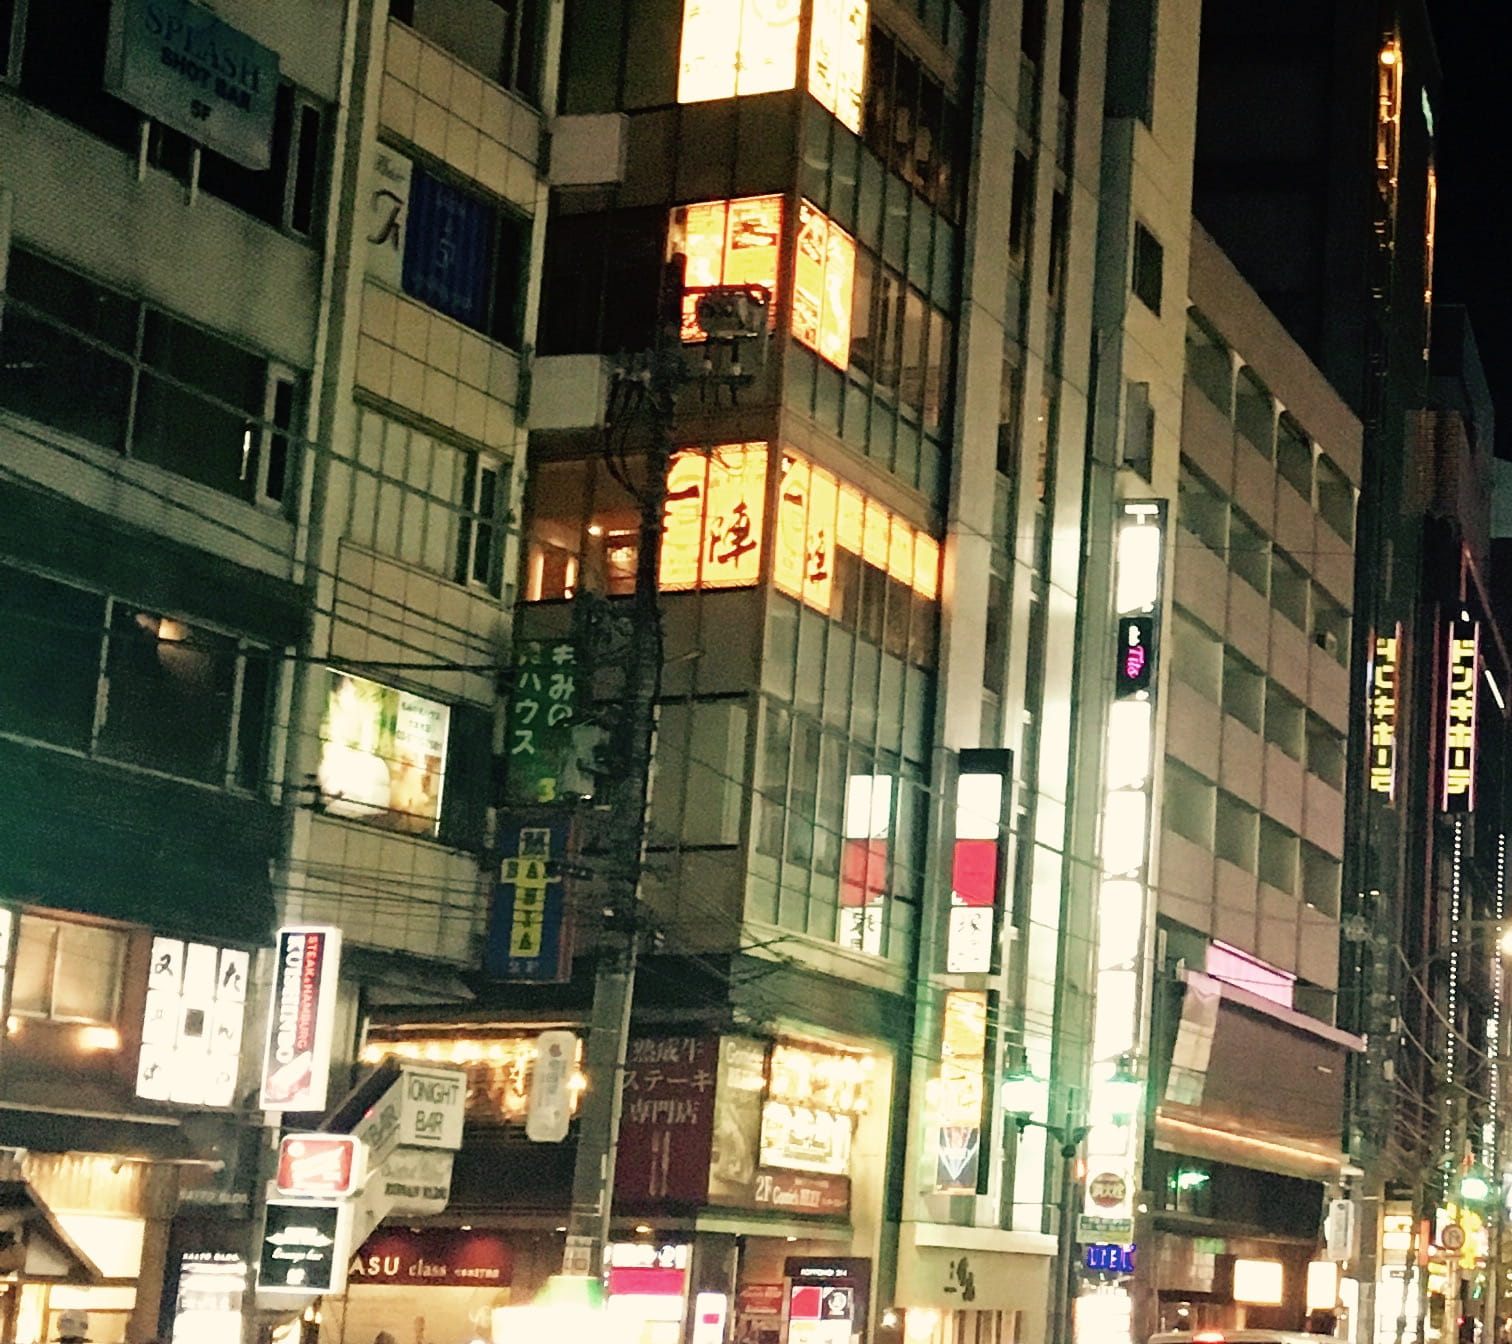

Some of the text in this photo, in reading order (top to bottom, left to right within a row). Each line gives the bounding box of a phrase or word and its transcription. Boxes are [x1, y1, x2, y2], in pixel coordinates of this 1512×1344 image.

[144, 6, 261, 94] SPLASH
[621, 1068, 714, 1093] ステーキ
